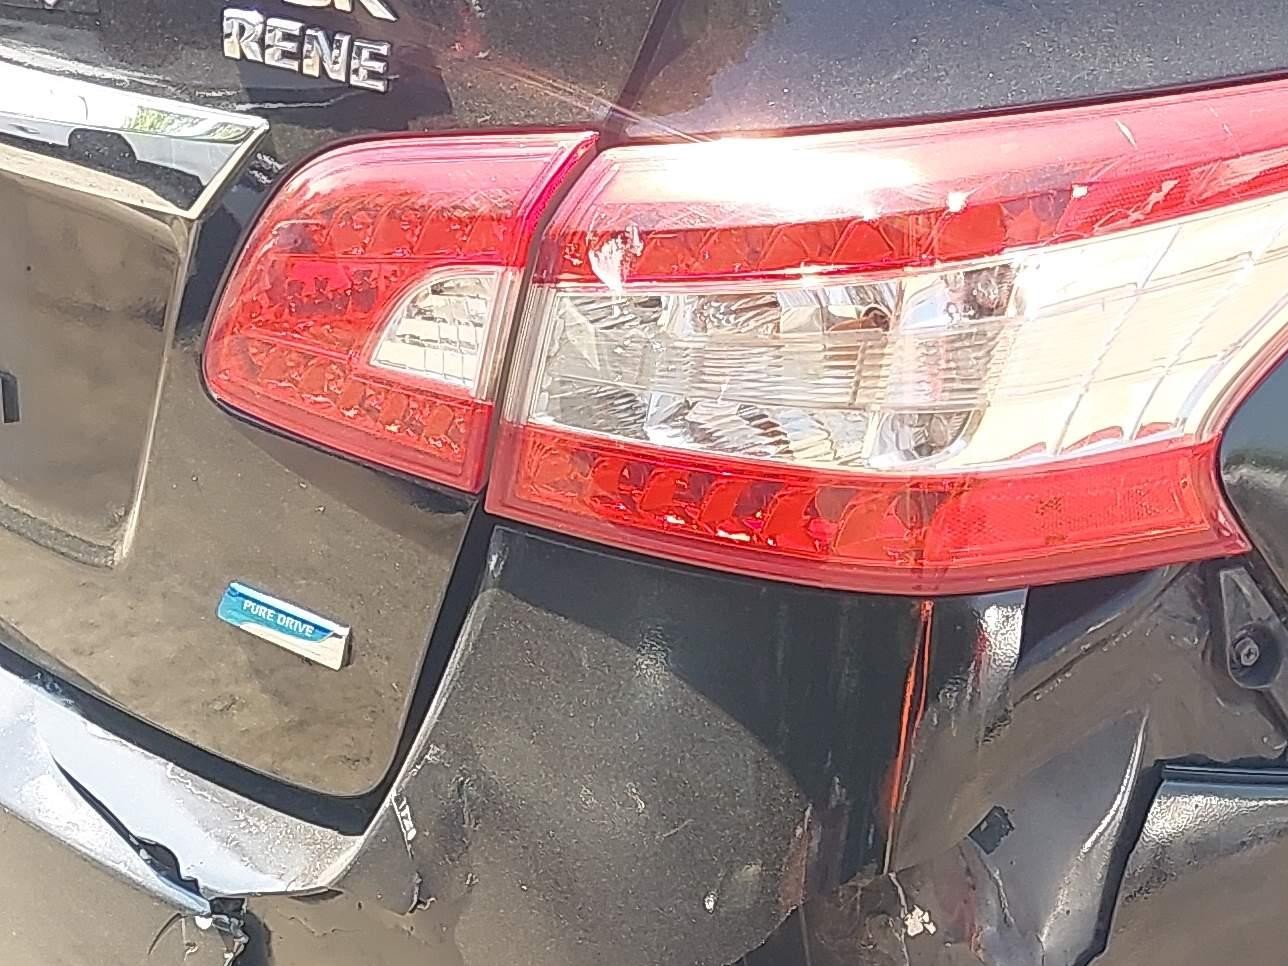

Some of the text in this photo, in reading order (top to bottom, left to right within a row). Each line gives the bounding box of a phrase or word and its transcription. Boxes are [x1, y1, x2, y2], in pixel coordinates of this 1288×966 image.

[223, 7, 391, 93] RENE
[242, 600, 315, 637] PURE DRIVE
